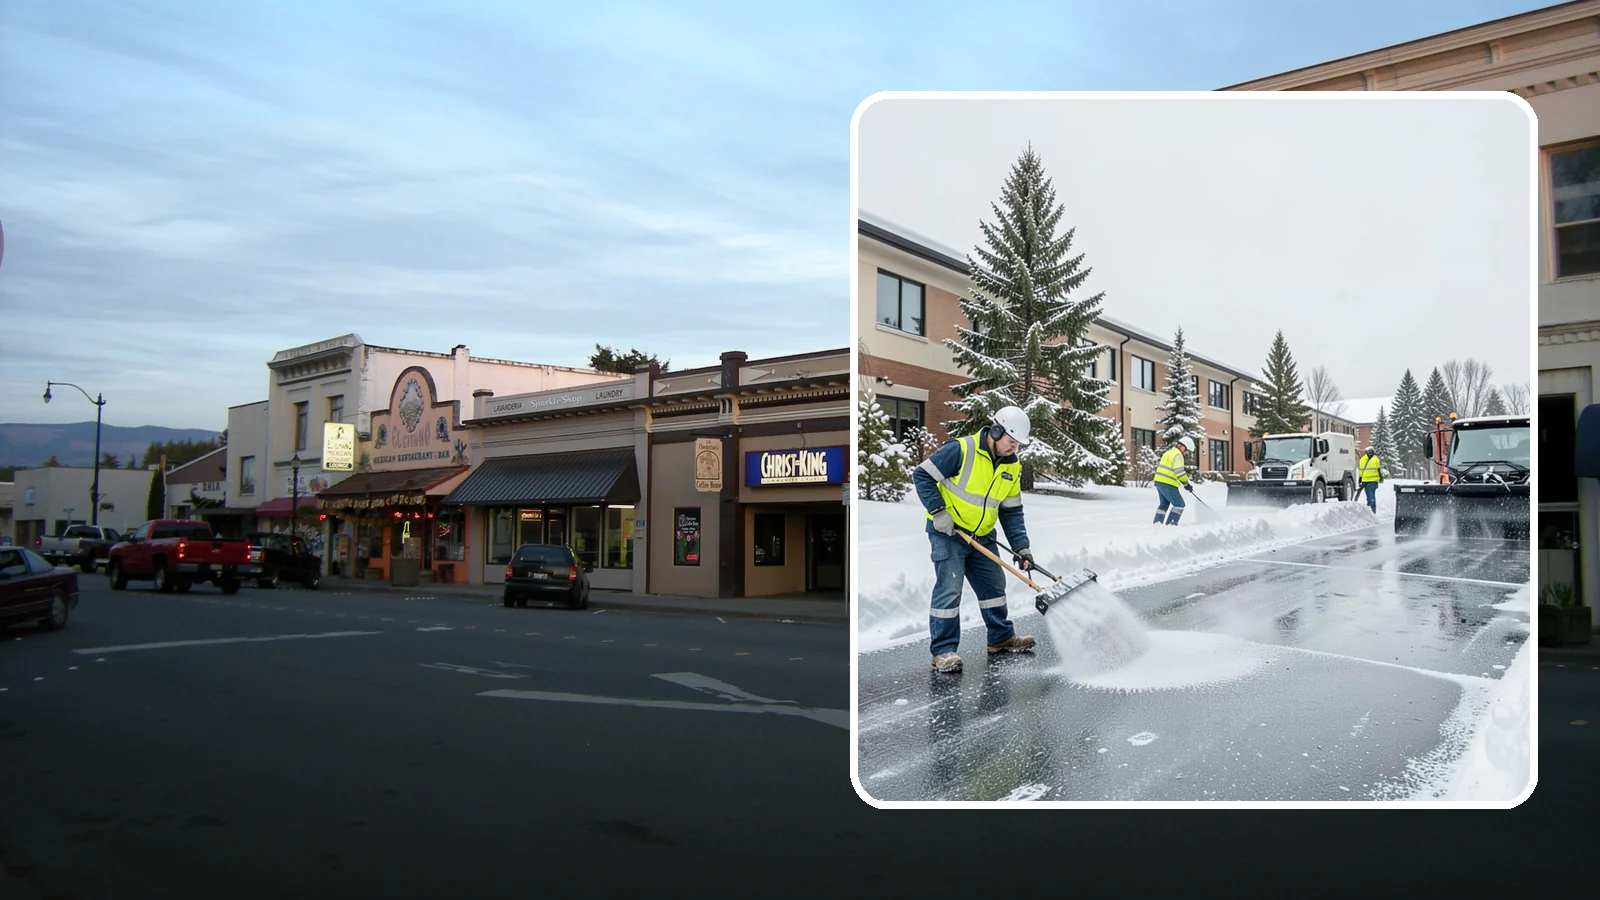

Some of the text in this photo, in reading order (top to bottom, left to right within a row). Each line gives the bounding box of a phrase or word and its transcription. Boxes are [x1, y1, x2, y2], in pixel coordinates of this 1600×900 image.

[530, 394, 583, 410] Sparkle Shop
[595, 388, 624, 400] LAUNDRY
[493, 402, 523, 413] LAVANDERIA
[392, 425, 402, 450] EL
[374, 454, 397, 465] MEXICAN
[397, 450, 434, 463] RESTAURANT
[437, 449, 450, 459] BAR
[760, 450, 828, 478] CHRIST KING
[696, 480, 722, 489] Coffee House
